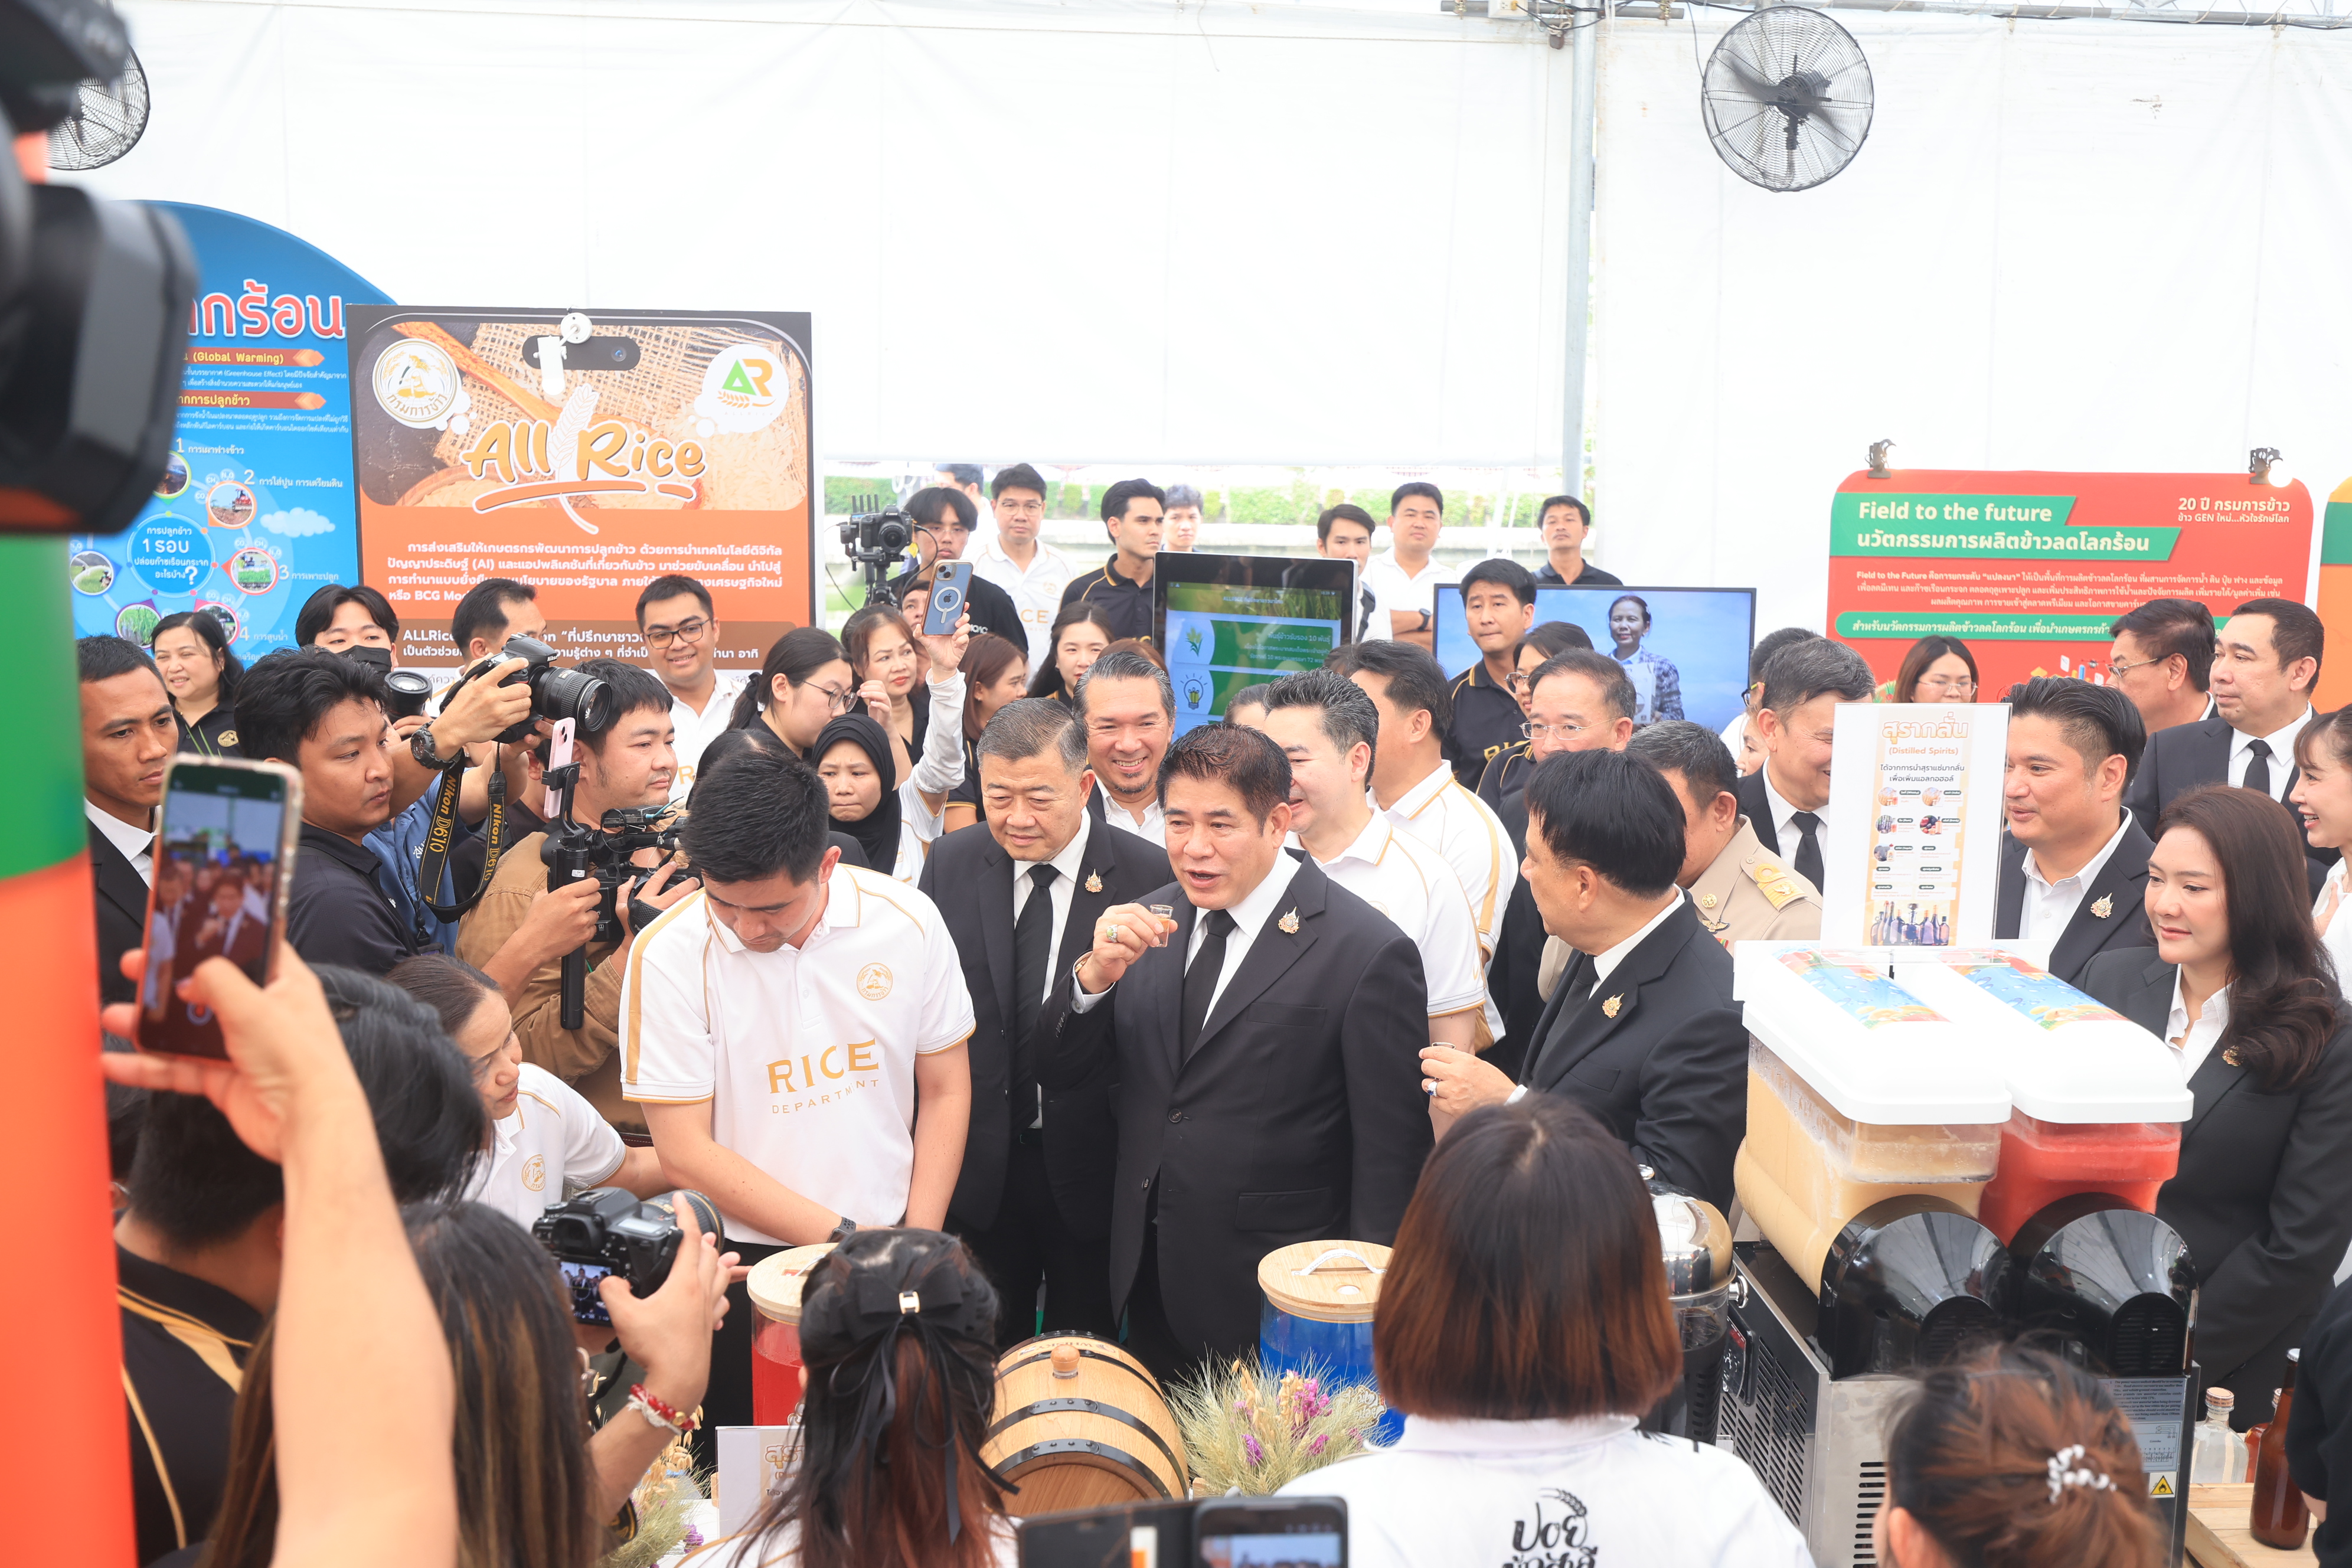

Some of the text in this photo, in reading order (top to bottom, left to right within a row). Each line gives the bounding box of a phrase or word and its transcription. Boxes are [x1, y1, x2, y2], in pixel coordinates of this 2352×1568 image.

[194, 352, 231, 362] (Global
[236, 352, 284, 365] Warming)
[178, 394, 250, 408] ากการปลูกข้าว
[386, 393, 449, 417] กรมการข้าว
[177, 437, 244, 455] 1 การเผาฟางข้าว
[462, 421, 705, 483] All Rice
[244, 469, 255, 485] 2
[296, 477, 343, 489] การเตรียมดิน
[1859, 501, 2052, 521] Field to the future
[2178, 496, 2291, 512] 20 ปี กรมการข้าว
[2178, 512, 2192, 522] ข้าว
[2195, 514, 2214, 522] GEN
[146, 526, 192, 537] การปลูกข้าว
[1858, 528, 2150, 551] นวัตกรรมการผลิตข้าวลดโลกร้อน
[143, 538, 190, 553] 1 รอบ
[408, 541, 782, 557] การส่งเสริมให้เกษตรกรพัฒนาการปลูกข้าว ด้วยการนำเทคโนโลยีดิจิทัล
[134, 557, 209, 568] ปล่อยก๊าซเรือนกระจก
[387, 556, 780, 574] ปัญญาประดิษฐ์ (AI) และแอปพลิเคชันที่เกี่ยวกับข้าว มาช่วยขับเคลื่อน นำไปสู่
[279, 565, 339, 583] 3 การเพาะปลูก
[1857, 570, 1875, 579] Field
[1887, 571, 1900, 579] the
[1902, 571, 1927, 580] Future
[1929, 570, 1981, 581] คือการยกระดับ
[1982, 573, 2021, 582] “แปลงนา”
[2022, 570, 2138, 583] ให้เป็นพื้นที่การผลิตข้าวลดโลกร้อน
[2139, 572, 2208, 584] ที่ผสานการจัดการน้ำ
[2210, 574, 2220, 583] ดิน
[2222, 574, 2232, 586] ปุ๋ย
[2233, 576, 2248, 584] ฟาง
[2249, 575, 2283, 587] และข้อมูล
[389, 591, 411, 600] หรือ
[415, 592, 440, 600] BCG
[1857, 581, 1899, 593] เพื่อลดมีเทน
[1900, 583, 1968, 594] และก๊าซเรือนกระจก
[1969, 584, 2030, 596] ตลอดฤดูเพาะปลูก
[2268, 588, 2281, 597] เช่น
[1931, 596, 1983, 608] ผลผลิตคุณภาพ
[1984, 596, 2073, 609] การขายเข้าสู่ตลาดพรีเมียม
[1020, 609, 1049, 623] CE
[239, 626, 288, 643] 4 การสูบน้ำ
[1853, 619, 2109, 635] สำหรับนวัตกรรมการผลิตข้าวลดโลกร้อน เพื่อนำเกษตรกรก้า
[605, 650, 613, 658] ๆ
[617, 646, 648, 658] ที่จำเป็
[739, 647, 759, 658] อาทิ
[1882, 711, 1969, 744] สุรากลั่น
[1889, 747, 1958, 756] (Distilled Spirits)
[1880, 762, 1965, 773] ได้จากการนำสุราแช่มากลั่น
[1889, 773, 1954, 782] เพื่อเพิ่มแอลกอฮอล์
[430, 775, 456, 852] Nikon D610
[484, 803, 502, 880] Nikon D610
[766, 1037, 879, 1093] RICE
